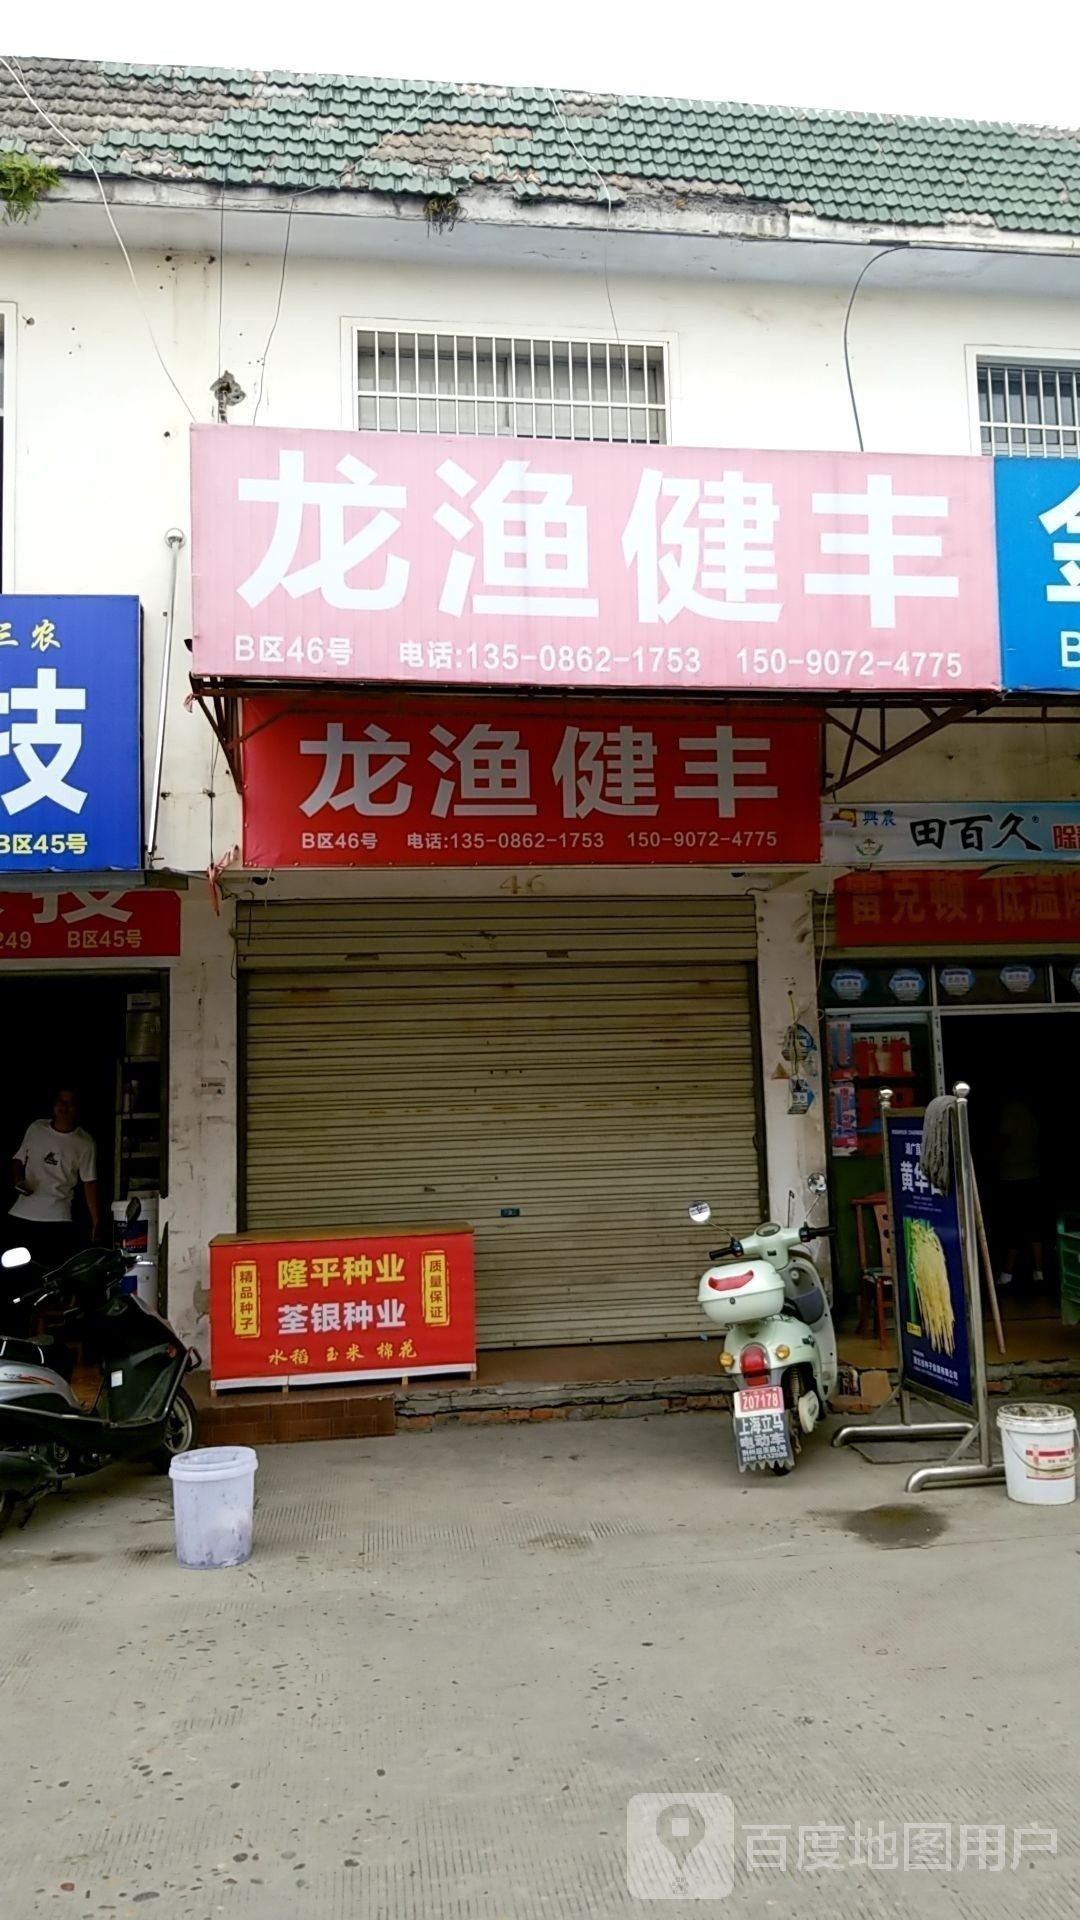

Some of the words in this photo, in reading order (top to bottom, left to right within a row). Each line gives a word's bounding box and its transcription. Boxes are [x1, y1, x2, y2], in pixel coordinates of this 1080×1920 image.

[236, 449, 959, 628] 龙渔健丰
[235, 635, 354, 667] B区46号
[400, 639, 701, 674] 电话:135-0862-1753
[736, 648, 962, 678] 150-9072-4775
[299, 722, 778, 819] 龙渔健丰
[302, 832, 378, 850] B区46号
[407, 831, 604, 849] 电话:135-0862-1753
[627, 831, 777, 848] 150-9072-4775
[909, 812, 1043, 851] 田百久
[499, 874, 545, 896] 46
[67, 929, 142, 950] B区45号
[900, 1160, 944, 1196] 黄华
[278, 1253, 405, 1289] 隆平种业
[239, 1270, 254, 1331] 精品种子
[429, 1260, 443, 1319] 质量保证
[278, 1298, 406, 1335] 荃银种业
[268, 1348, 309, 1366] 水稻
[377, 1339, 418, 1359] 棉花
[739, 1413, 784, 1436] 上海立马
[739, 1432, 786, 1450] 电动车
